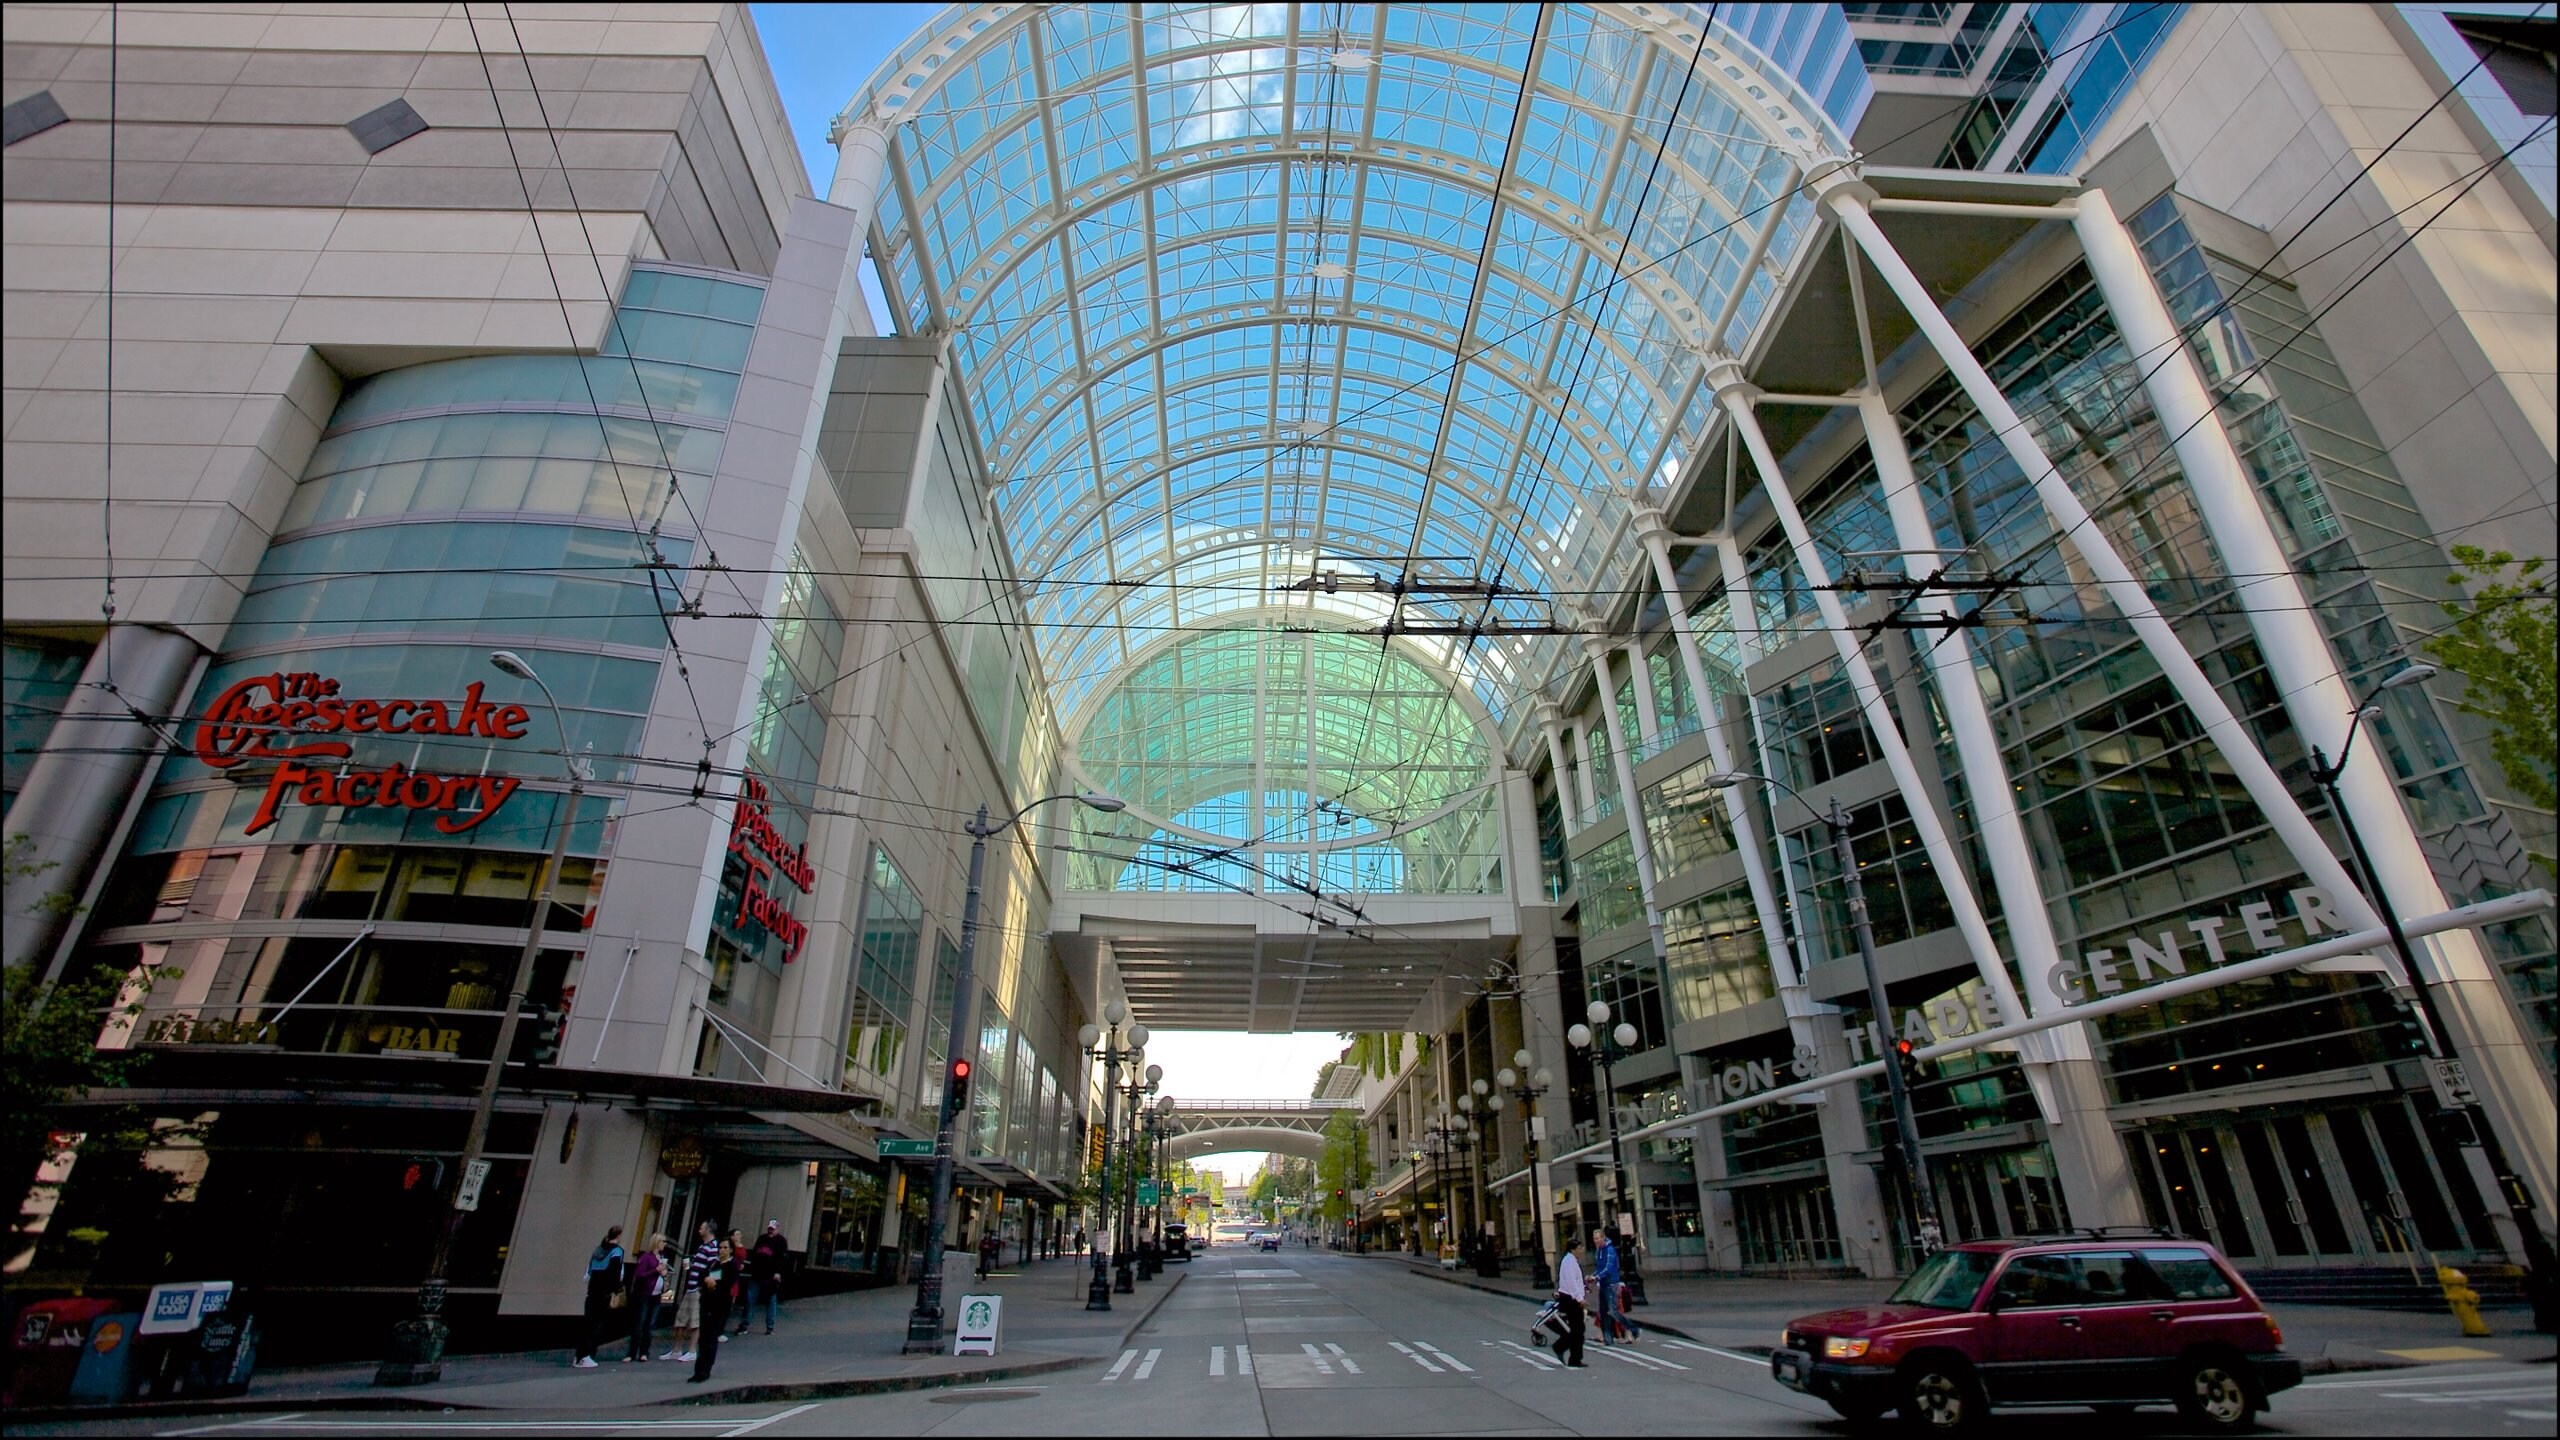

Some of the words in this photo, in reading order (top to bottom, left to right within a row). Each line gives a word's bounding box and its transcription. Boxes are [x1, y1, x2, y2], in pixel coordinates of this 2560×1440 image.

[285, 671, 341, 699] The
[196, 672, 531, 768] Cheesecake
[244, 760, 522, 836] Factory
[735, 864, 808, 964] Factory
[1614, 1056, 1776, 1132] ONVENTION
[1792, 1044, 1821, 1079] &
[2047, 886, 2352, 1002] CENTER
[388, 1026, 461, 1052] BAR
[2440, 1063, 2463, 1077] ONE
[2442, 1075, 2466, 1088] WAY
[915, 1144, 930, 1152] Ave
[469, 1163, 485, 1177] ONE
[465, 1176, 481, 1189] WAY
[170, 1294, 190, 1305] USA
[157, 1303, 187, 1315] TODAY
